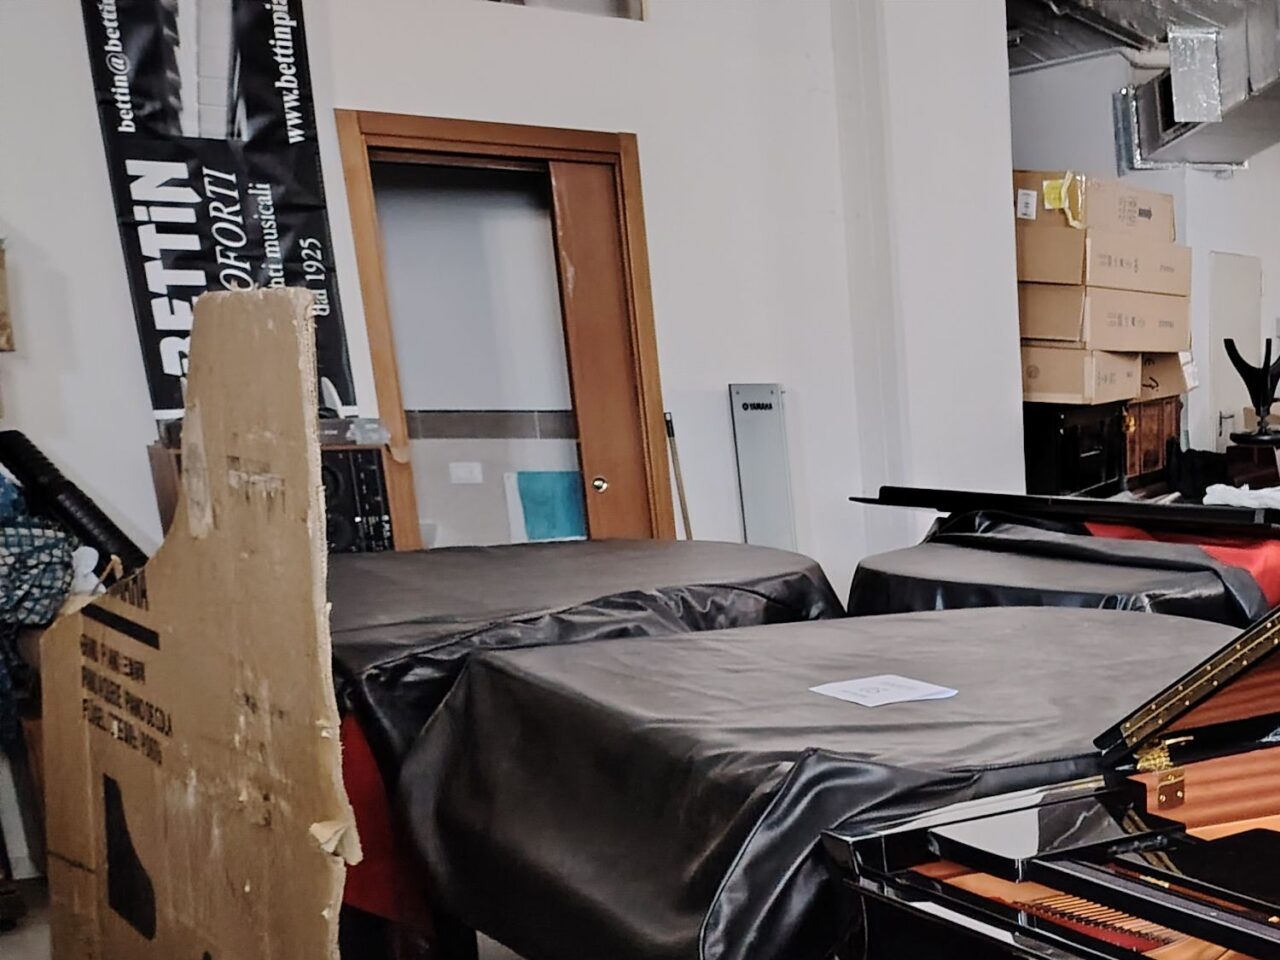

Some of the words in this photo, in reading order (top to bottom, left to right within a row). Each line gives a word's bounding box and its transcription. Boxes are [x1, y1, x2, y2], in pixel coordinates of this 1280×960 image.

[202, 166, 254, 292] OFORTI
[248, 182, 281, 262] musicali
[299, 237, 326, 284] 1925
